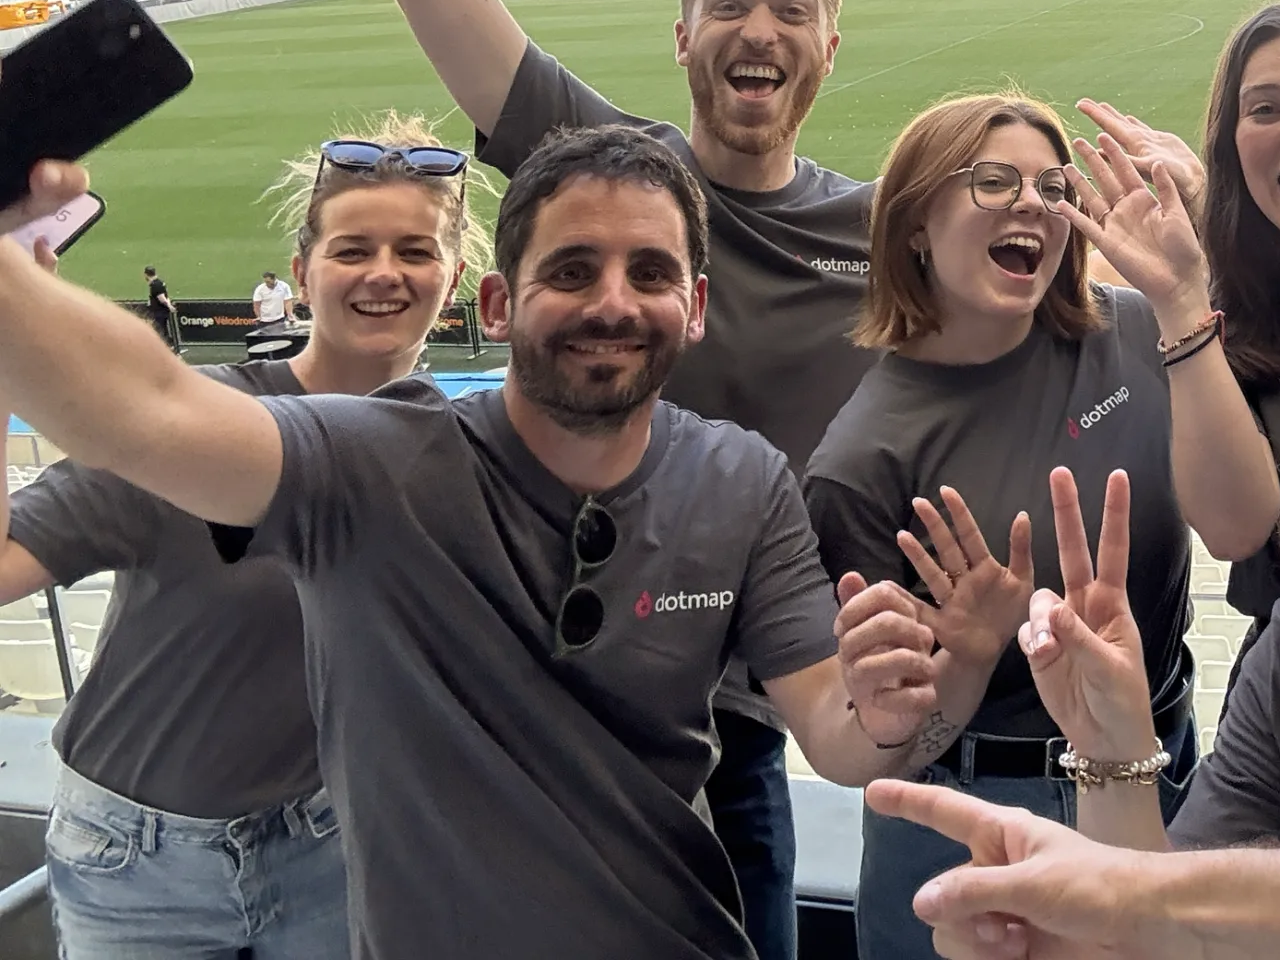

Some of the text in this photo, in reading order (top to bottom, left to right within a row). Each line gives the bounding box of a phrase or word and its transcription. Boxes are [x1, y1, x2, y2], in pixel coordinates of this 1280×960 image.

[811, 257, 870, 275] dotmap
[180, 316, 214, 327] Orange
[1080, 386, 1130, 429] dotmap
[655, 590, 734, 612] dotmap
